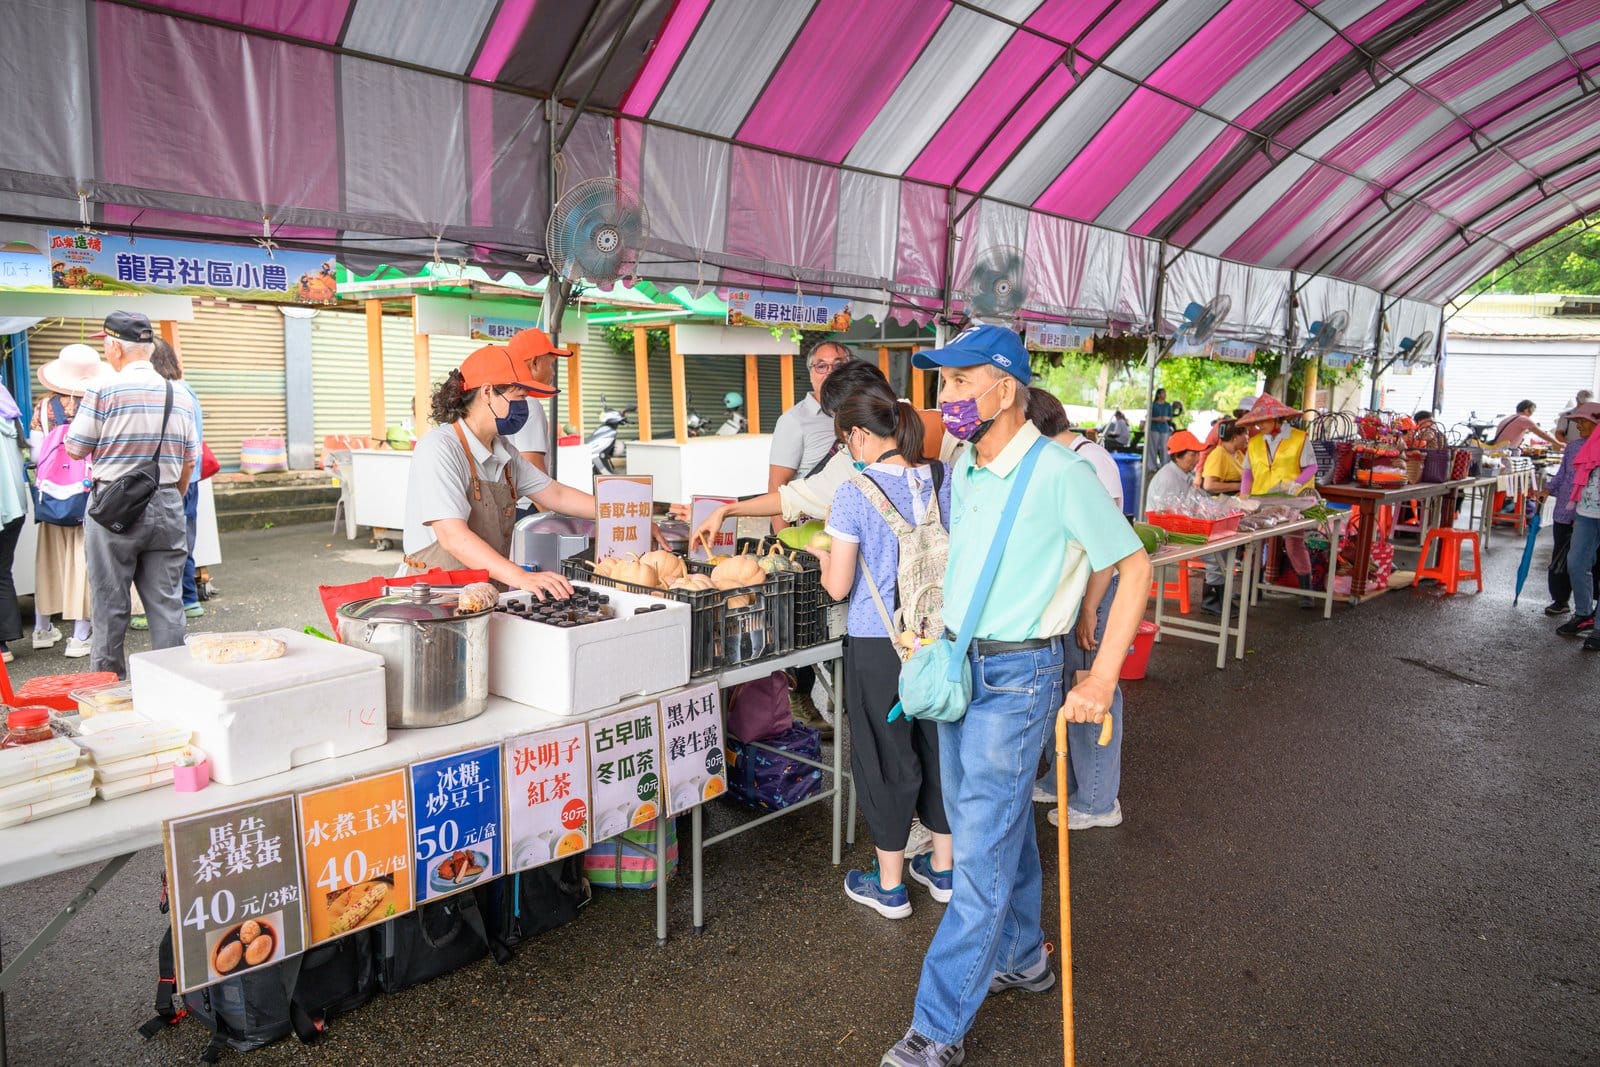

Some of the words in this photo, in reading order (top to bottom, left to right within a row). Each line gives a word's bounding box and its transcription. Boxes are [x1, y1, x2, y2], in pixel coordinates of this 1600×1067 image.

[117, 253, 287, 291] 龍昇社區小農
[754, 302, 828, 323] 龍昇社區小農
[599, 502, 650, 518] 香取牛奶
[612, 526, 637, 542] 南瓜
[667, 692, 715, 729] 黑木耳
[594, 715, 653, 753] 古早味
[669, 724, 718, 760] 養生露
[513, 737, 580, 776] 決明子
[596, 748, 654, 784] 冬瓜茶
[705, 754, 723, 769] 30元
[436, 760, 480, 791] 冰糖
[528, 772, 571, 807] 紅茶
[637, 779, 658, 795] 30元
[426, 778, 491, 818] 炒豆干
[562, 806, 586, 823] 30元
[210, 816, 266, 851] 馬告
[304, 799, 407, 846] 水煮玉米
[192, 836, 282, 884] 茶葉蛋
